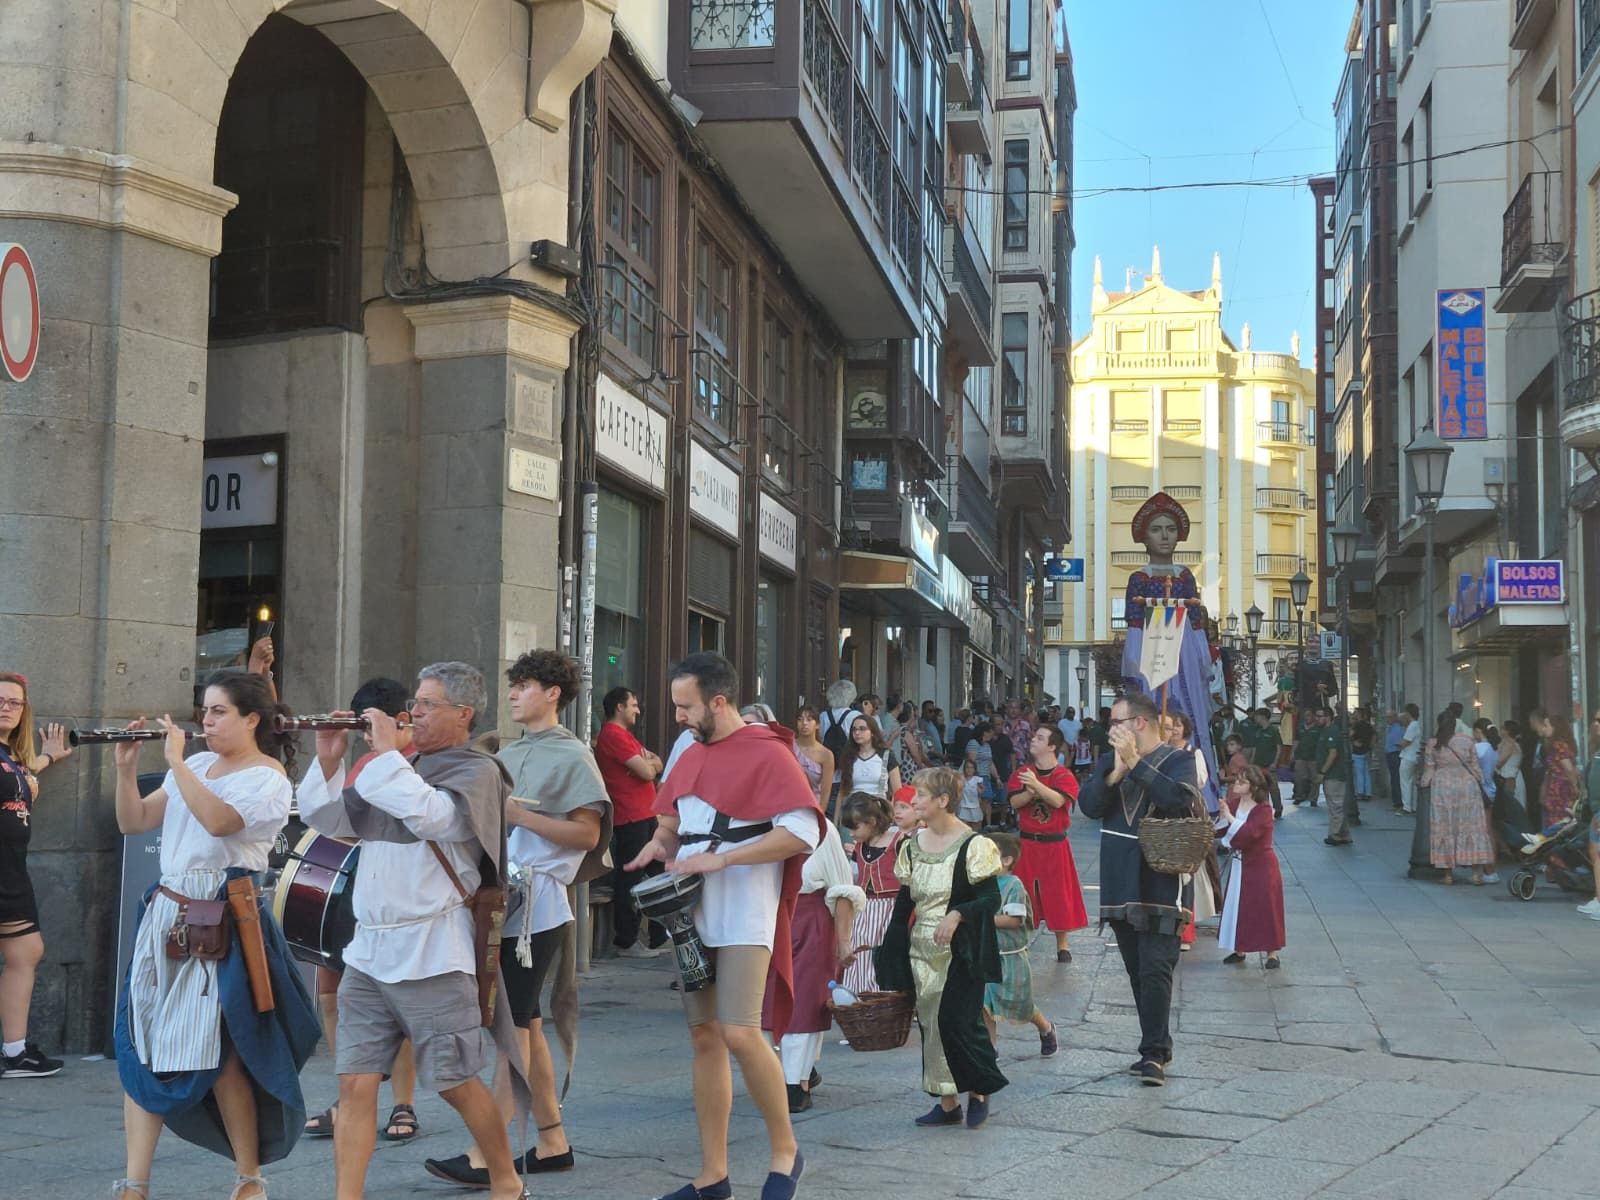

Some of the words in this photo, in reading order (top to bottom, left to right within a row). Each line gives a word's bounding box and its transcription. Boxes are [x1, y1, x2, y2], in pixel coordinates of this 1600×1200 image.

[1463, 328, 1484, 435] BOLSOS
[1502, 566, 1556, 580] BOLSOS
[1499, 585, 1560, 599] MALETAS
